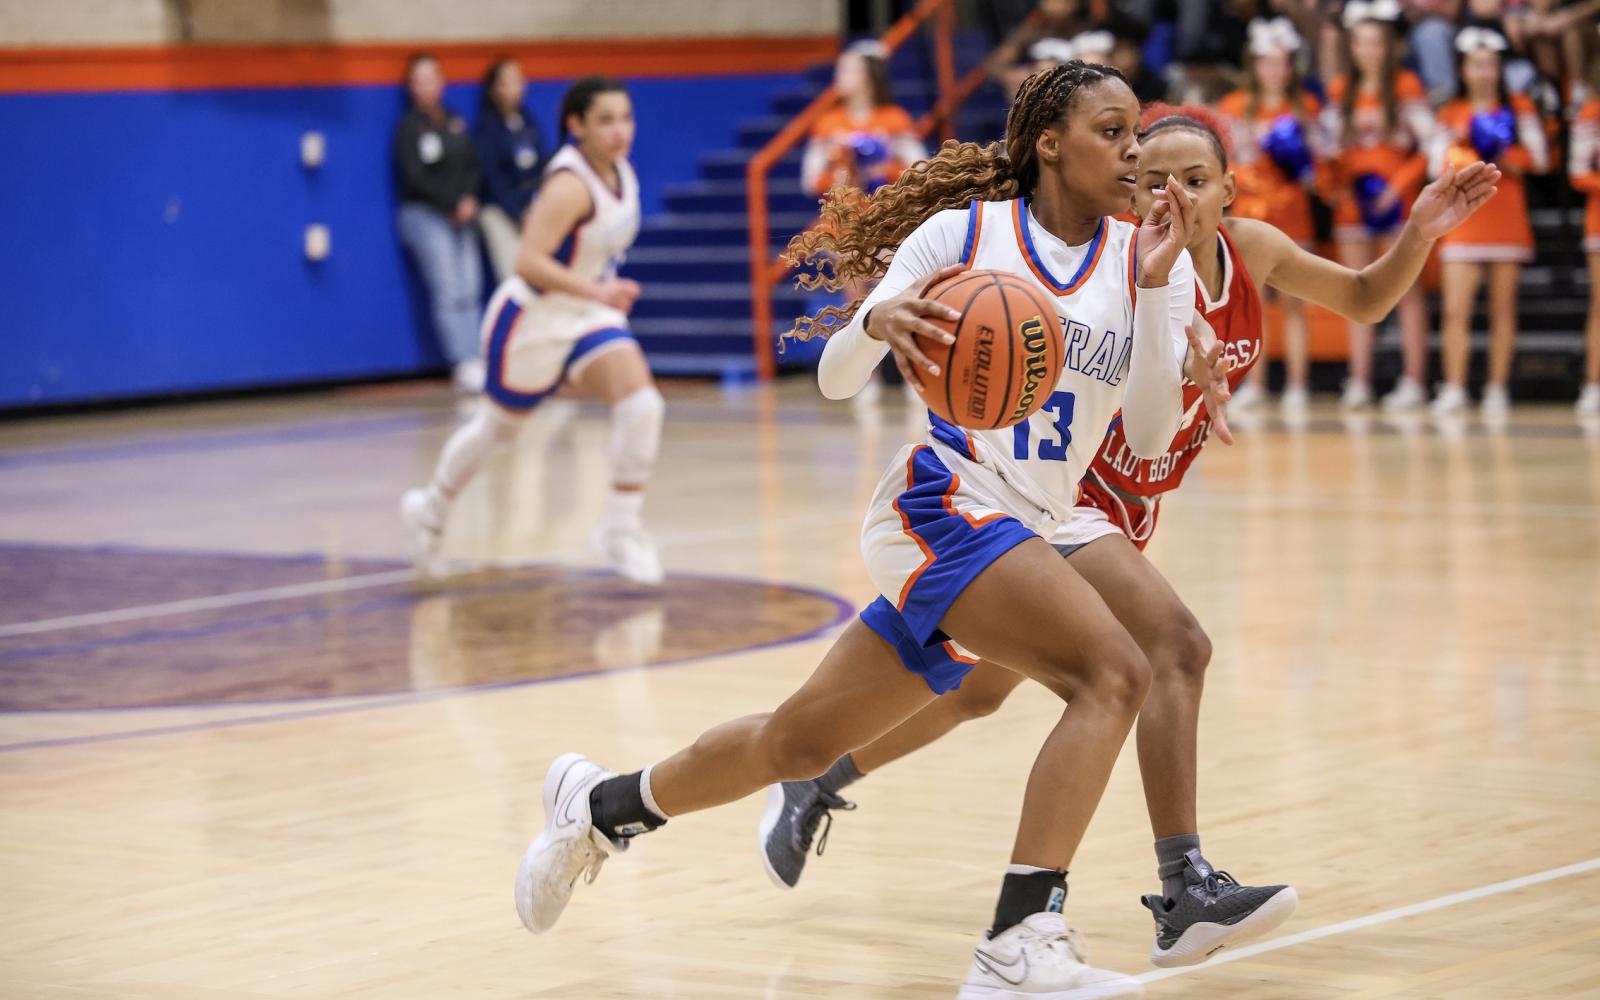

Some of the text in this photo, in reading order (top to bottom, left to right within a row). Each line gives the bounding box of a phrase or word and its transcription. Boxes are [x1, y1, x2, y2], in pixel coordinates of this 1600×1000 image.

[971, 325, 994, 420] EVOLUTION
[1008, 315, 1048, 423] Wilson
[1058, 315, 1132, 387] RAL
[1013, 390, 1076, 462] 13
